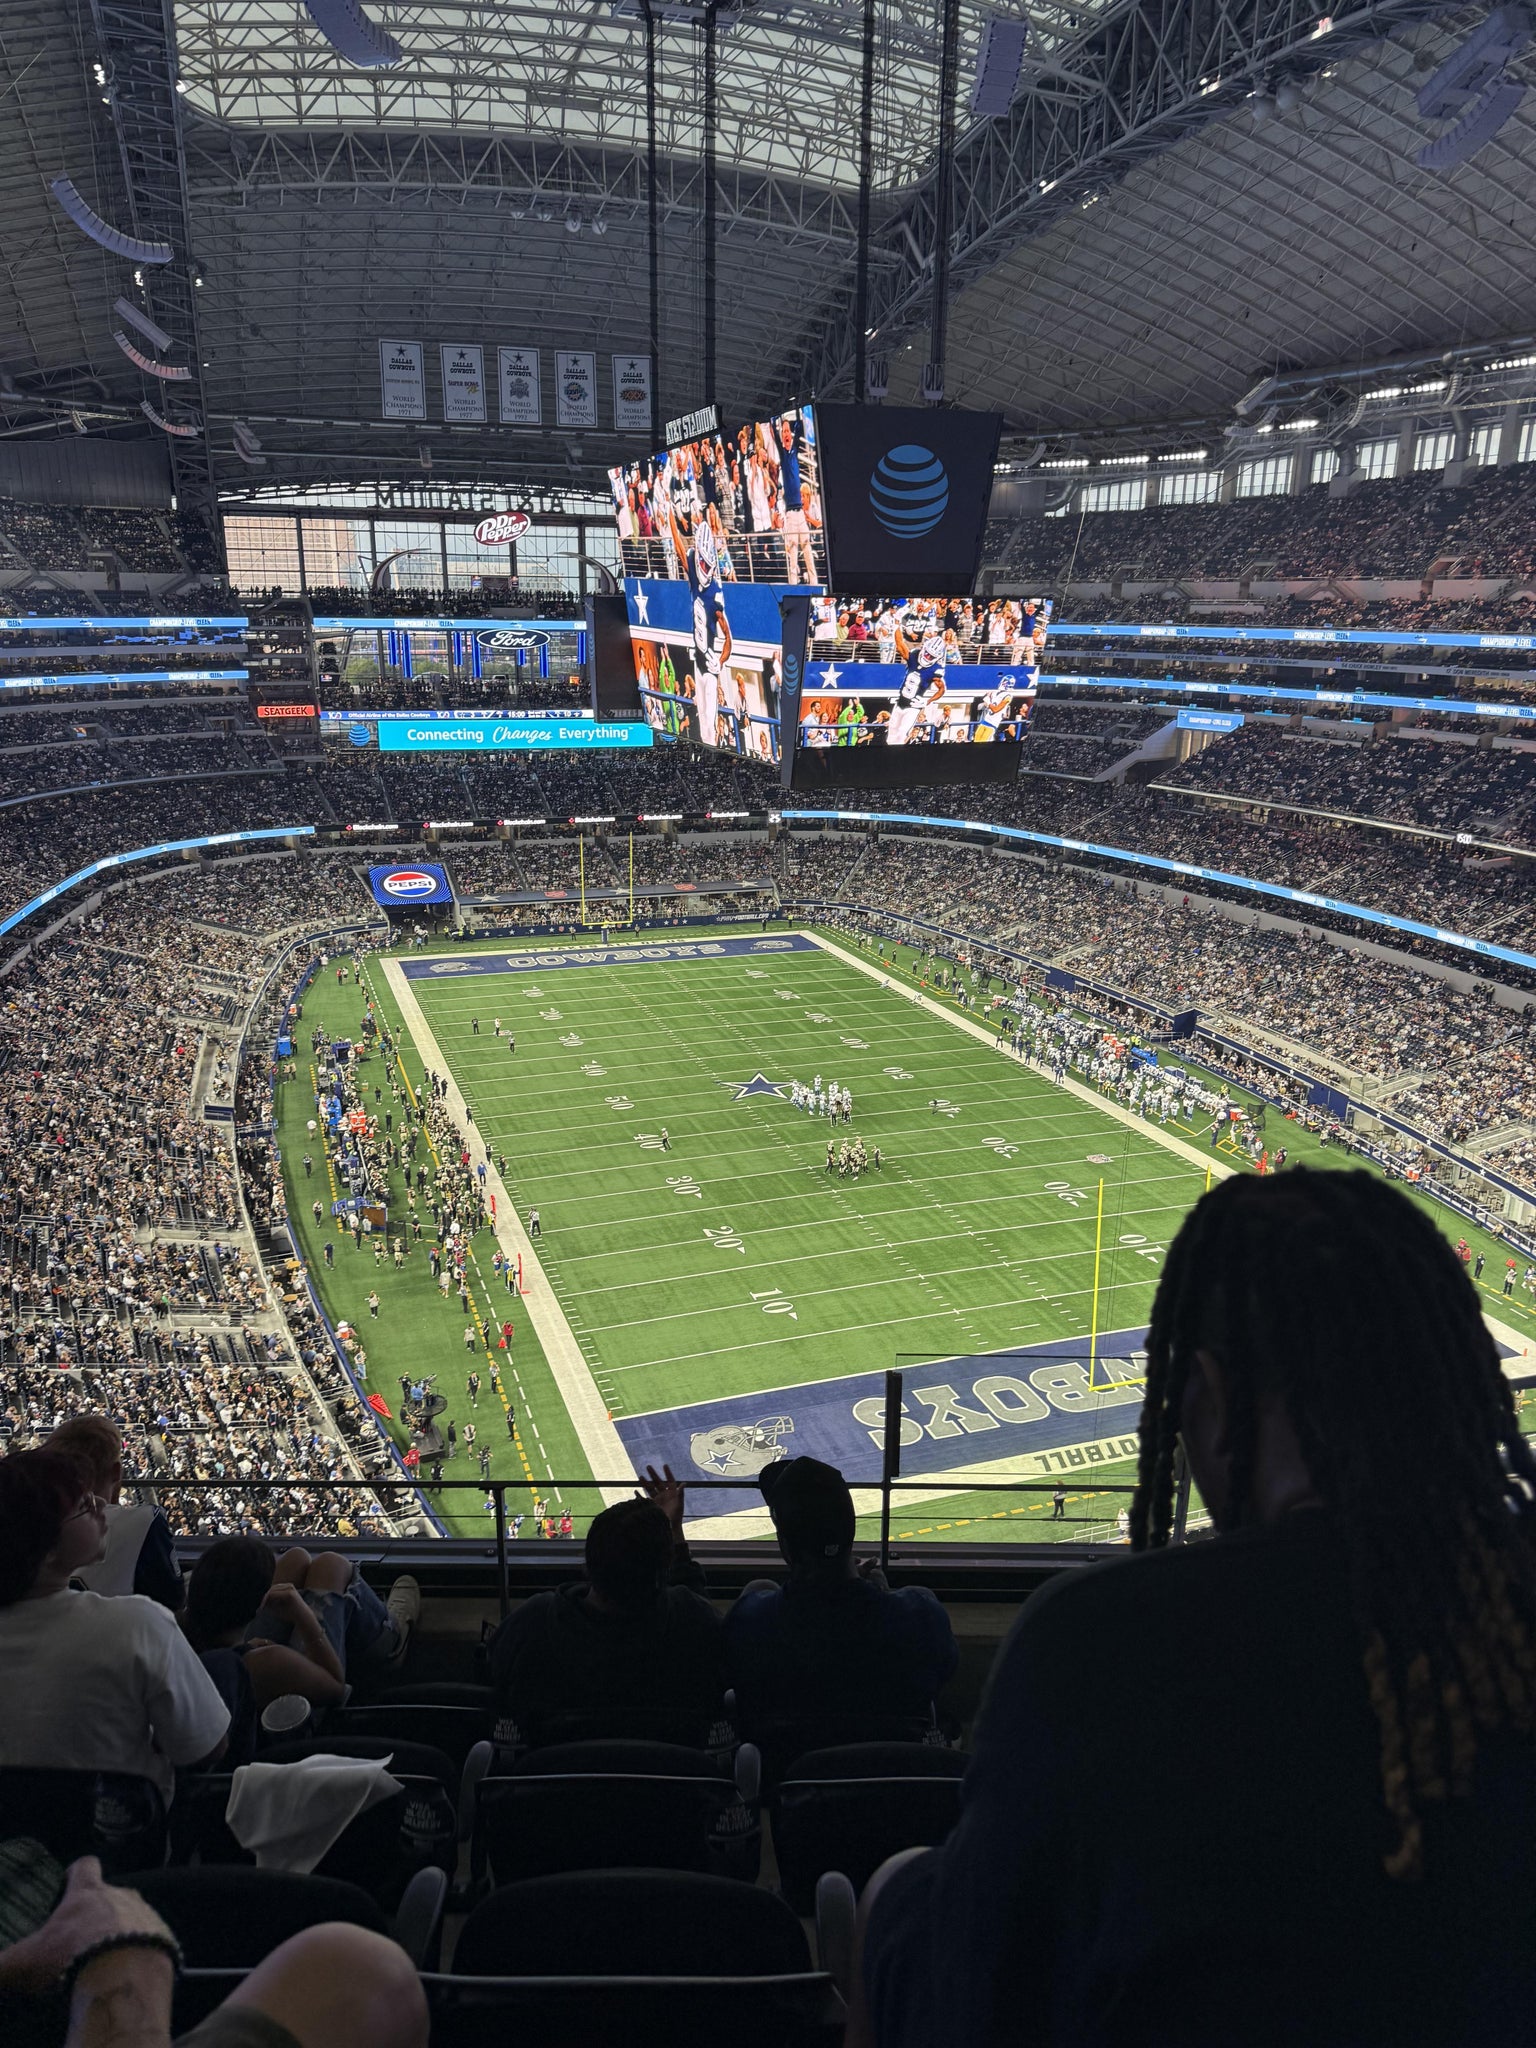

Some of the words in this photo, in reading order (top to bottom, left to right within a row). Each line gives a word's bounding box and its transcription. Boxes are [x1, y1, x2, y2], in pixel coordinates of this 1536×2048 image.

[666, 418, 683, 446] AT&T
[682, 404, 718, 440] STADIUM
[481, 518, 527, 542] Pepper
[495, 514, 517, 529] Dr
[491, 629, 537, 647] Ford
[264, 706, 307, 715] SEATGEEK
[407, 728, 484, 743] Connecting
[492, 726, 552, 743] Changes
[388, 880, 432, 888] PEPSI
[506, 943, 726, 968] COWBOYS
[604, 1095, 635, 1110] 50
[665, 1175, 700, 1195] 30
[1044, 1181, 1088, 1201] 20
[702, 1225, 743, 1249] 20
[1118, 1234, 1167, 1256] 10
[750, 1287, 794, 1314] 10
[1034, 1438, 1139, 1472] OTBALL
